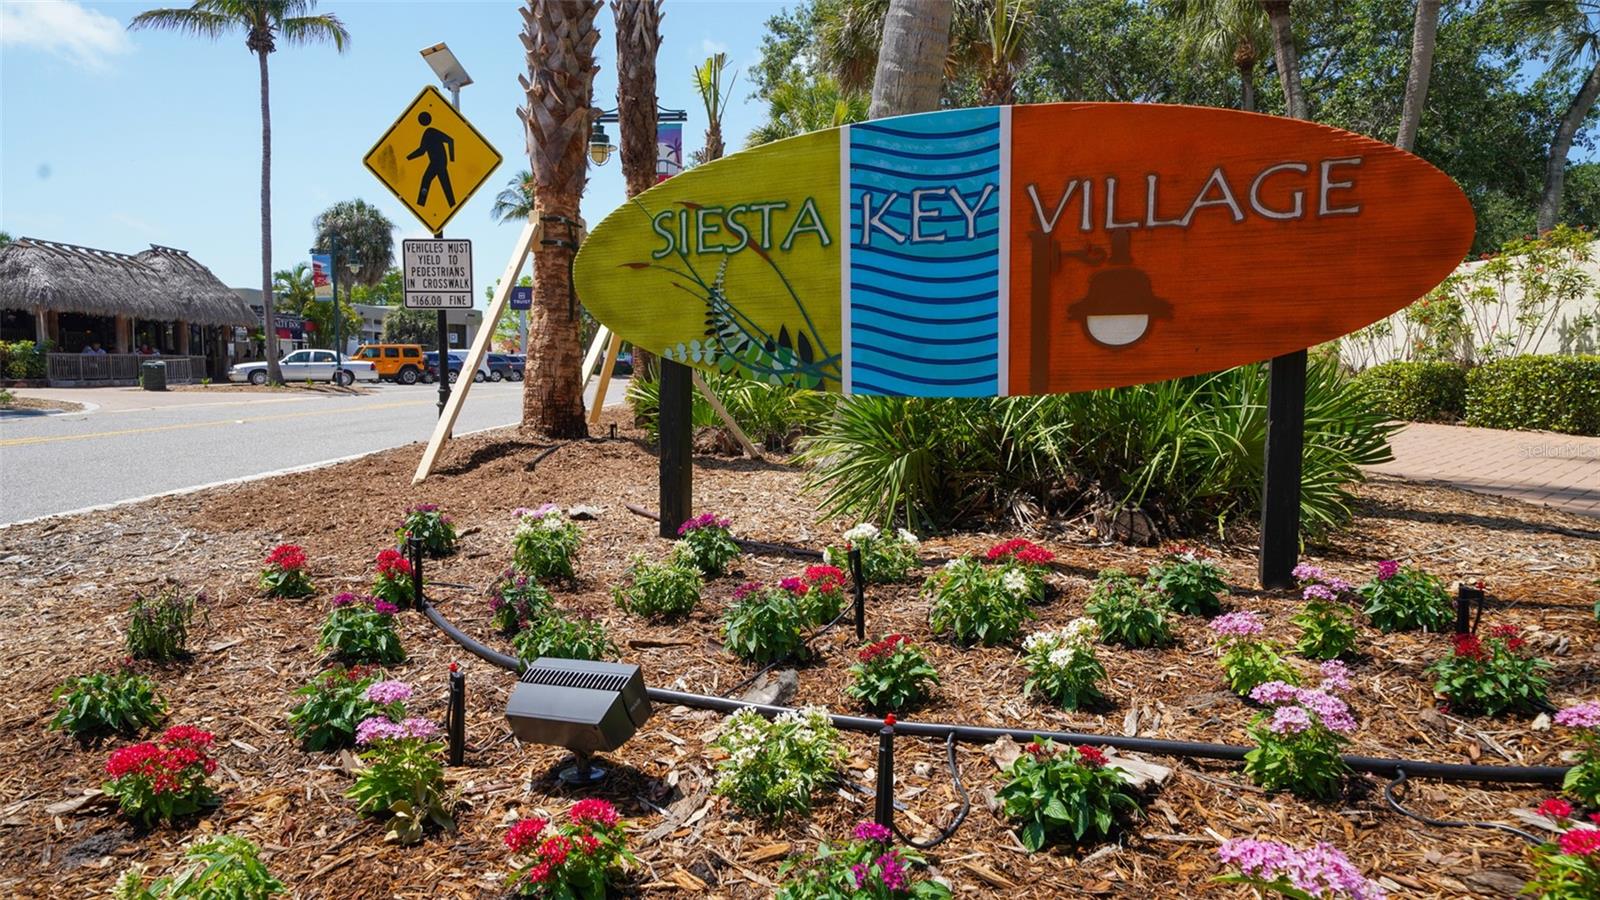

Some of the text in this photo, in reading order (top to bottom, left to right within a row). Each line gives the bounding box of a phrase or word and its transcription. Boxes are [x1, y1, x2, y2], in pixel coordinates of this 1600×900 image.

[652, 156, 1363, 260] SIESTA KEY VILLAGE
[406, 243, 468, 253] VEHICLES MUST
[418, 255, 458, 265] YIELD TO
[411, 267, 465, 277] PEDESTRIANS
[407, 279, 470, 289] IN CROSSWALK
[412, 296, 467, 306] $166.00 FINE
